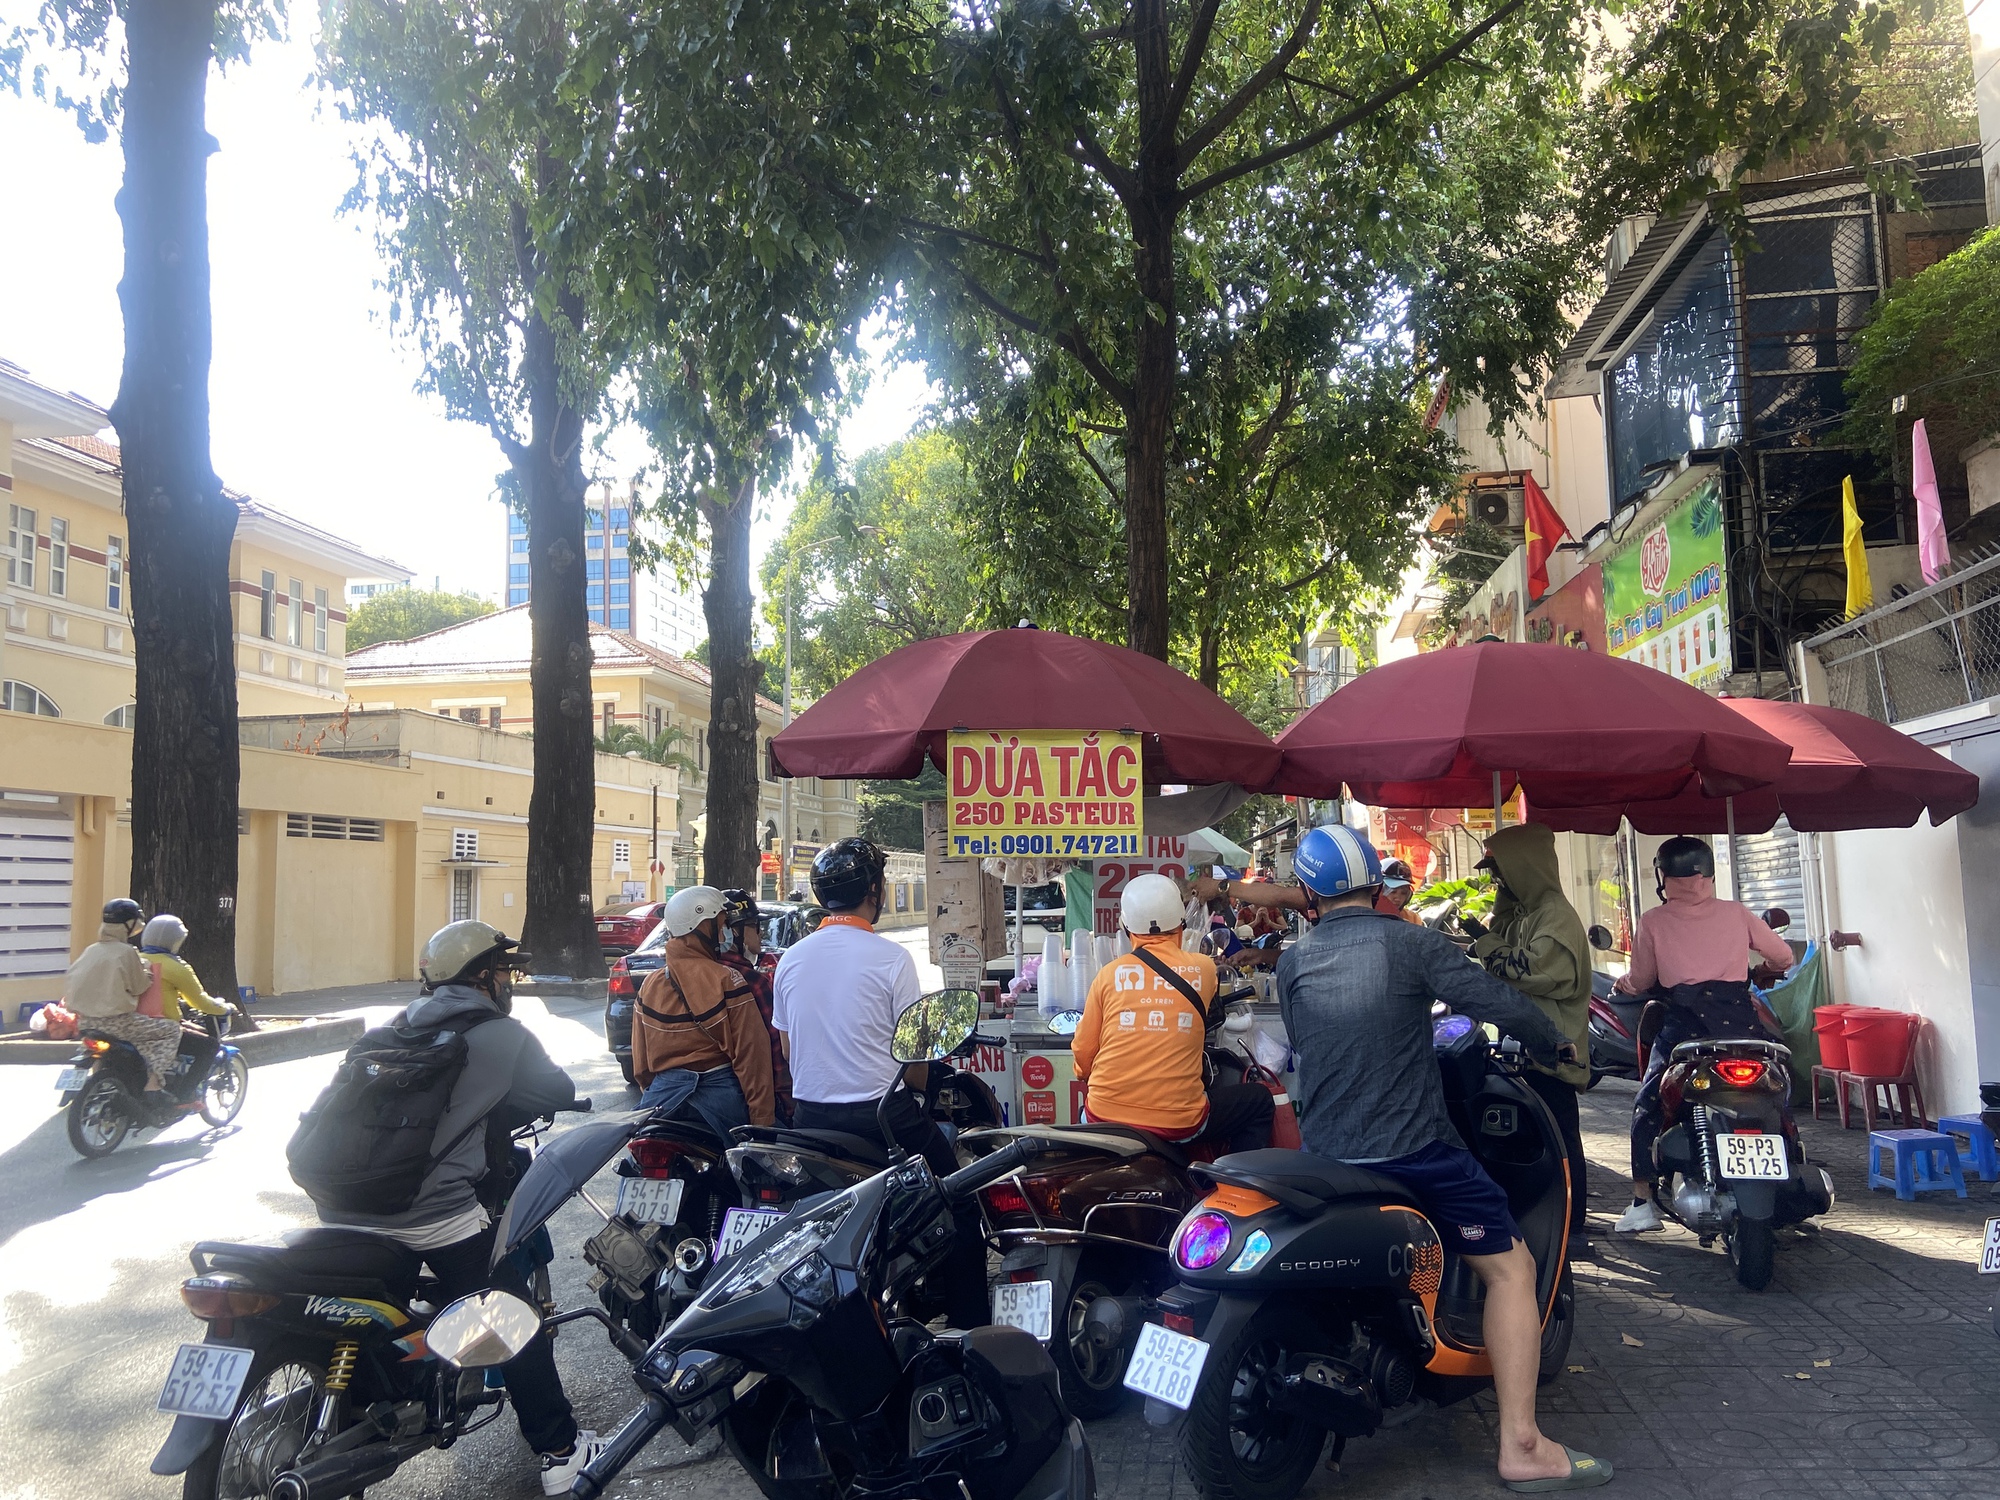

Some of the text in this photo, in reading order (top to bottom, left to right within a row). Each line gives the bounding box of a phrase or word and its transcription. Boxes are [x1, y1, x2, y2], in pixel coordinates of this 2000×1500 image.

[1609, 619, 1625, 651] Trà
[1625, 607, 1644, 642] Trái
[1645, 600, 1663, 633] Cây
[1690, 563, 1721, 605] 100%
[952, 731, 1137, 798] DỪA TẮC
[955, 802, 1135, 825] 250 PASTEUR
[953, 835, 1138, 855] Tel: 0901.747211
[1315, 859, 1325, 868] HT
[218, 897, 233, 908] 377
[1170, 965, 1201, 977] opee
[1153, 974, 1202, 992] Fod
[1030, 1074, 1046, 1082] Foody
[1727, 1138, 1774, 1156] 59-P3
[1727, 1157, 1782, 1176] 451.25
[631, 1181, 672, 1200] 54-F1
[1107, 1191, 1163, 1200] LEAD
[628, 1202, 669, 1221] 7079
[1279, 1258, 1361, 1271] SCOOPY
[304, 1294, 372, 1316] Wave
[1002, 1286, 1041, 1312] 59-S1
[341, 1317, 372, 1327] 110
[1145, 1330, 1197, 1371] 59-E2
[181, 1350, 239, 1382] 59-K1
[1129, 1357, 1192, 1403] 241.88
[166, 1378, 237, 1414] 512.57
